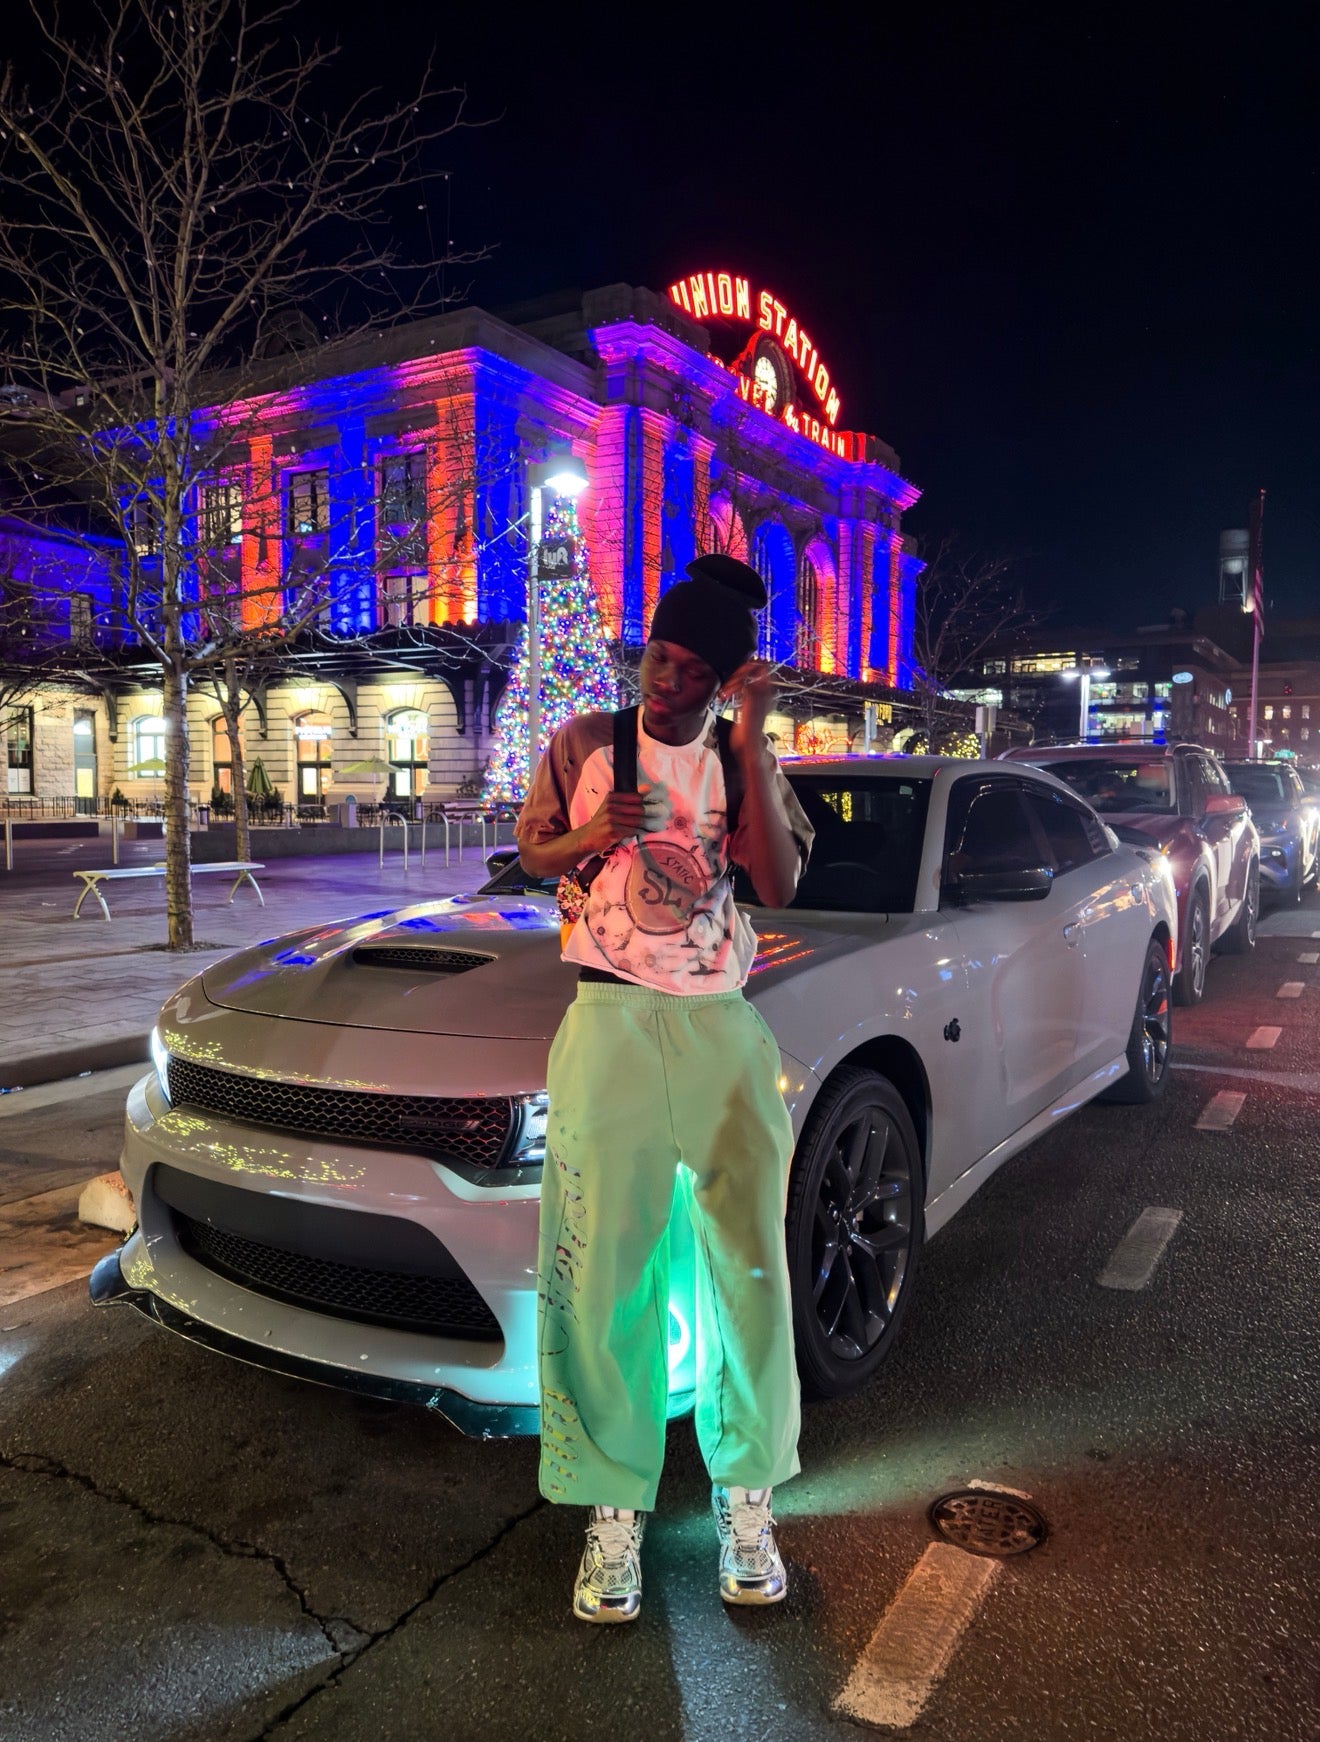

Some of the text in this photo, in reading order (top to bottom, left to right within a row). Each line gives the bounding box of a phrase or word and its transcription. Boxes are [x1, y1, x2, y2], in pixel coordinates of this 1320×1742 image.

[671, 272, 841, 425] UNION STATION
[802, 413, 846, 458] TRAIN
[659, 856, 694, 885] STATIC
